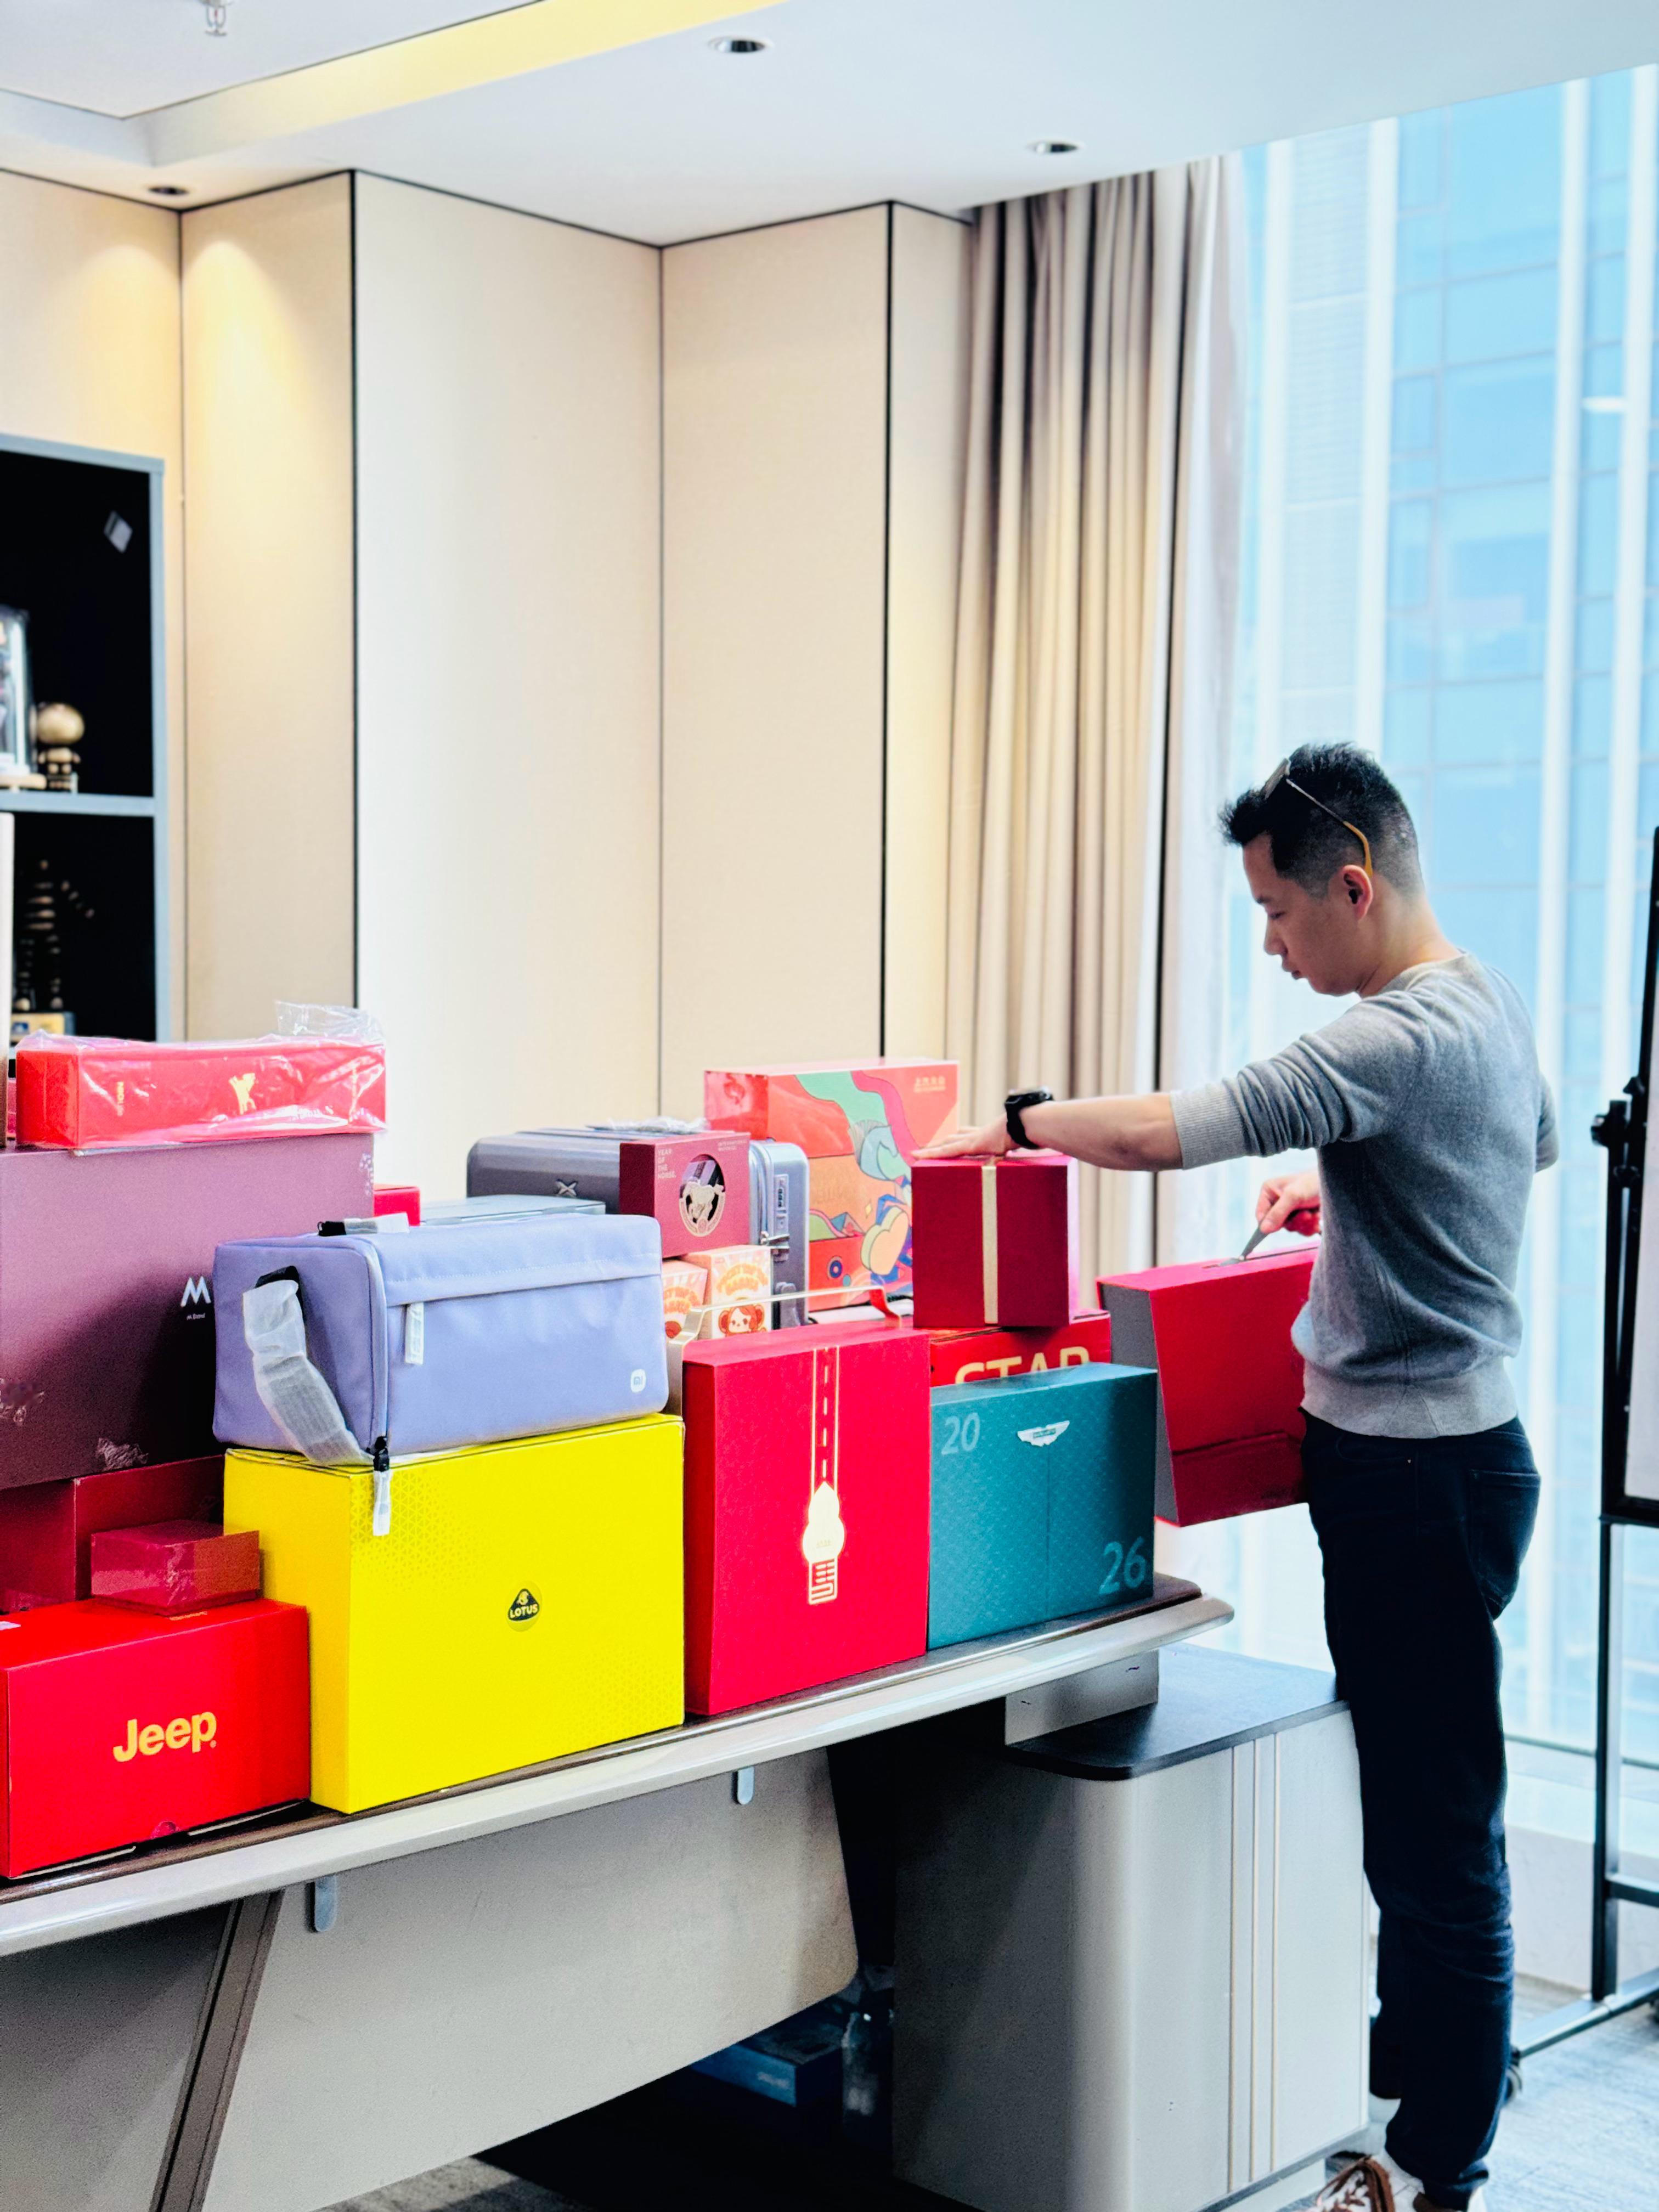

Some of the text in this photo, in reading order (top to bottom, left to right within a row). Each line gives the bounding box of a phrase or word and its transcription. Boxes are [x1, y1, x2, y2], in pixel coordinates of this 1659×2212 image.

[941, 1413, 980, 1455] 20
[1099, 1537, 1146, 1594] 26
[510, 1604, 538, 1618] LOTUS
